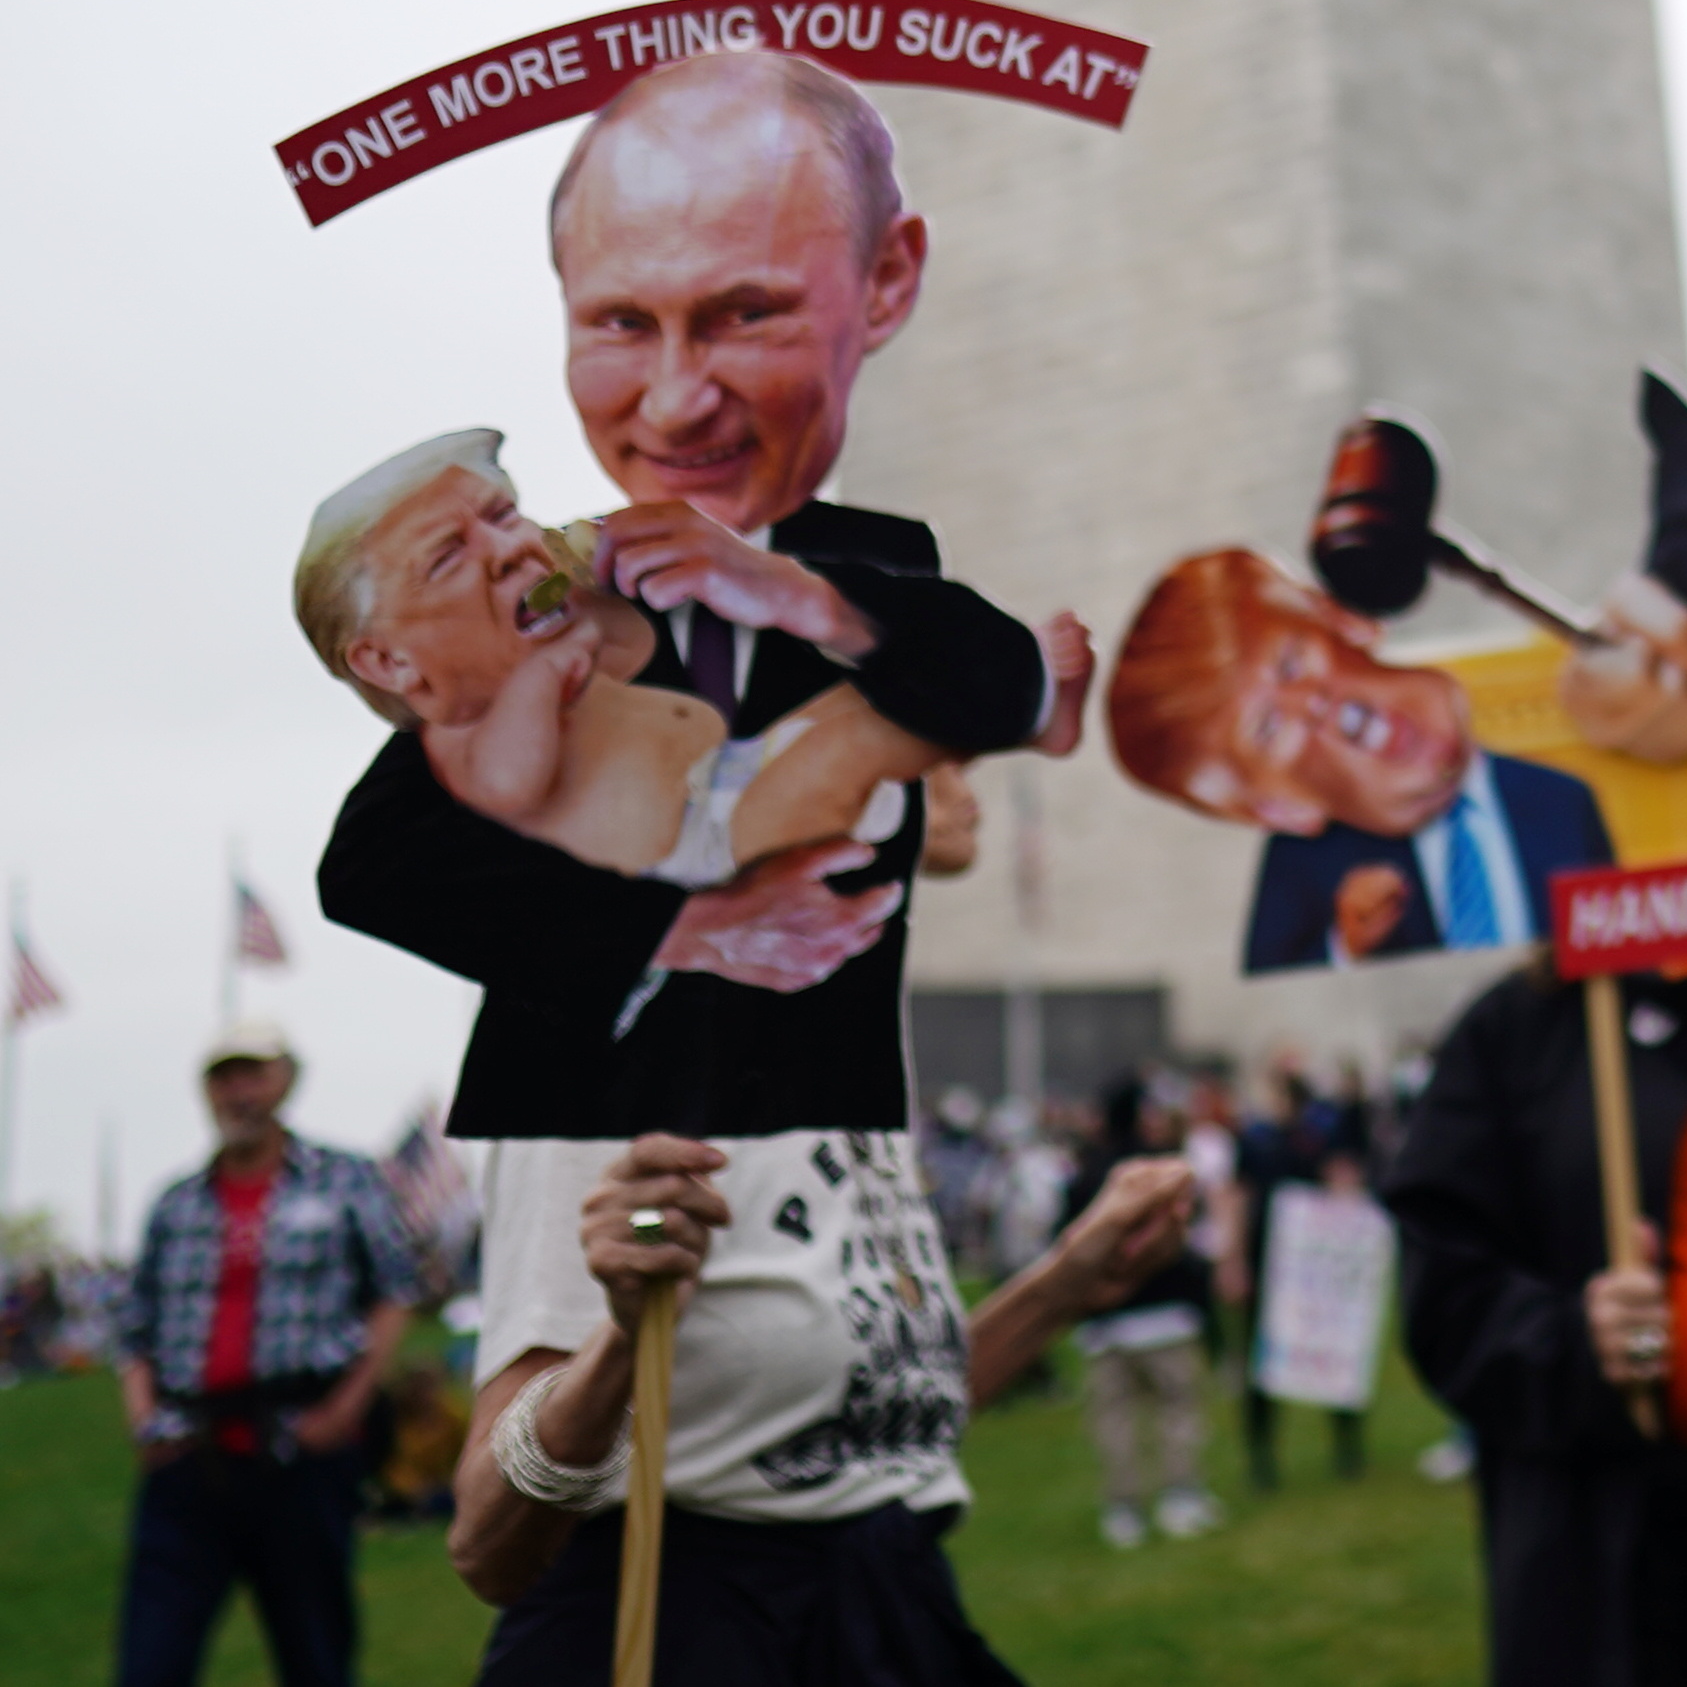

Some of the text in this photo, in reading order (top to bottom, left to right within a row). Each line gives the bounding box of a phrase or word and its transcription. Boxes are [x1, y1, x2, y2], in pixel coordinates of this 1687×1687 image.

[427, 35, 587, 128] MORE
[593, 6, 757, 71] THING
[771, 3, 884, 51] YOU
[895, 9, 1042, 81] SUCK
